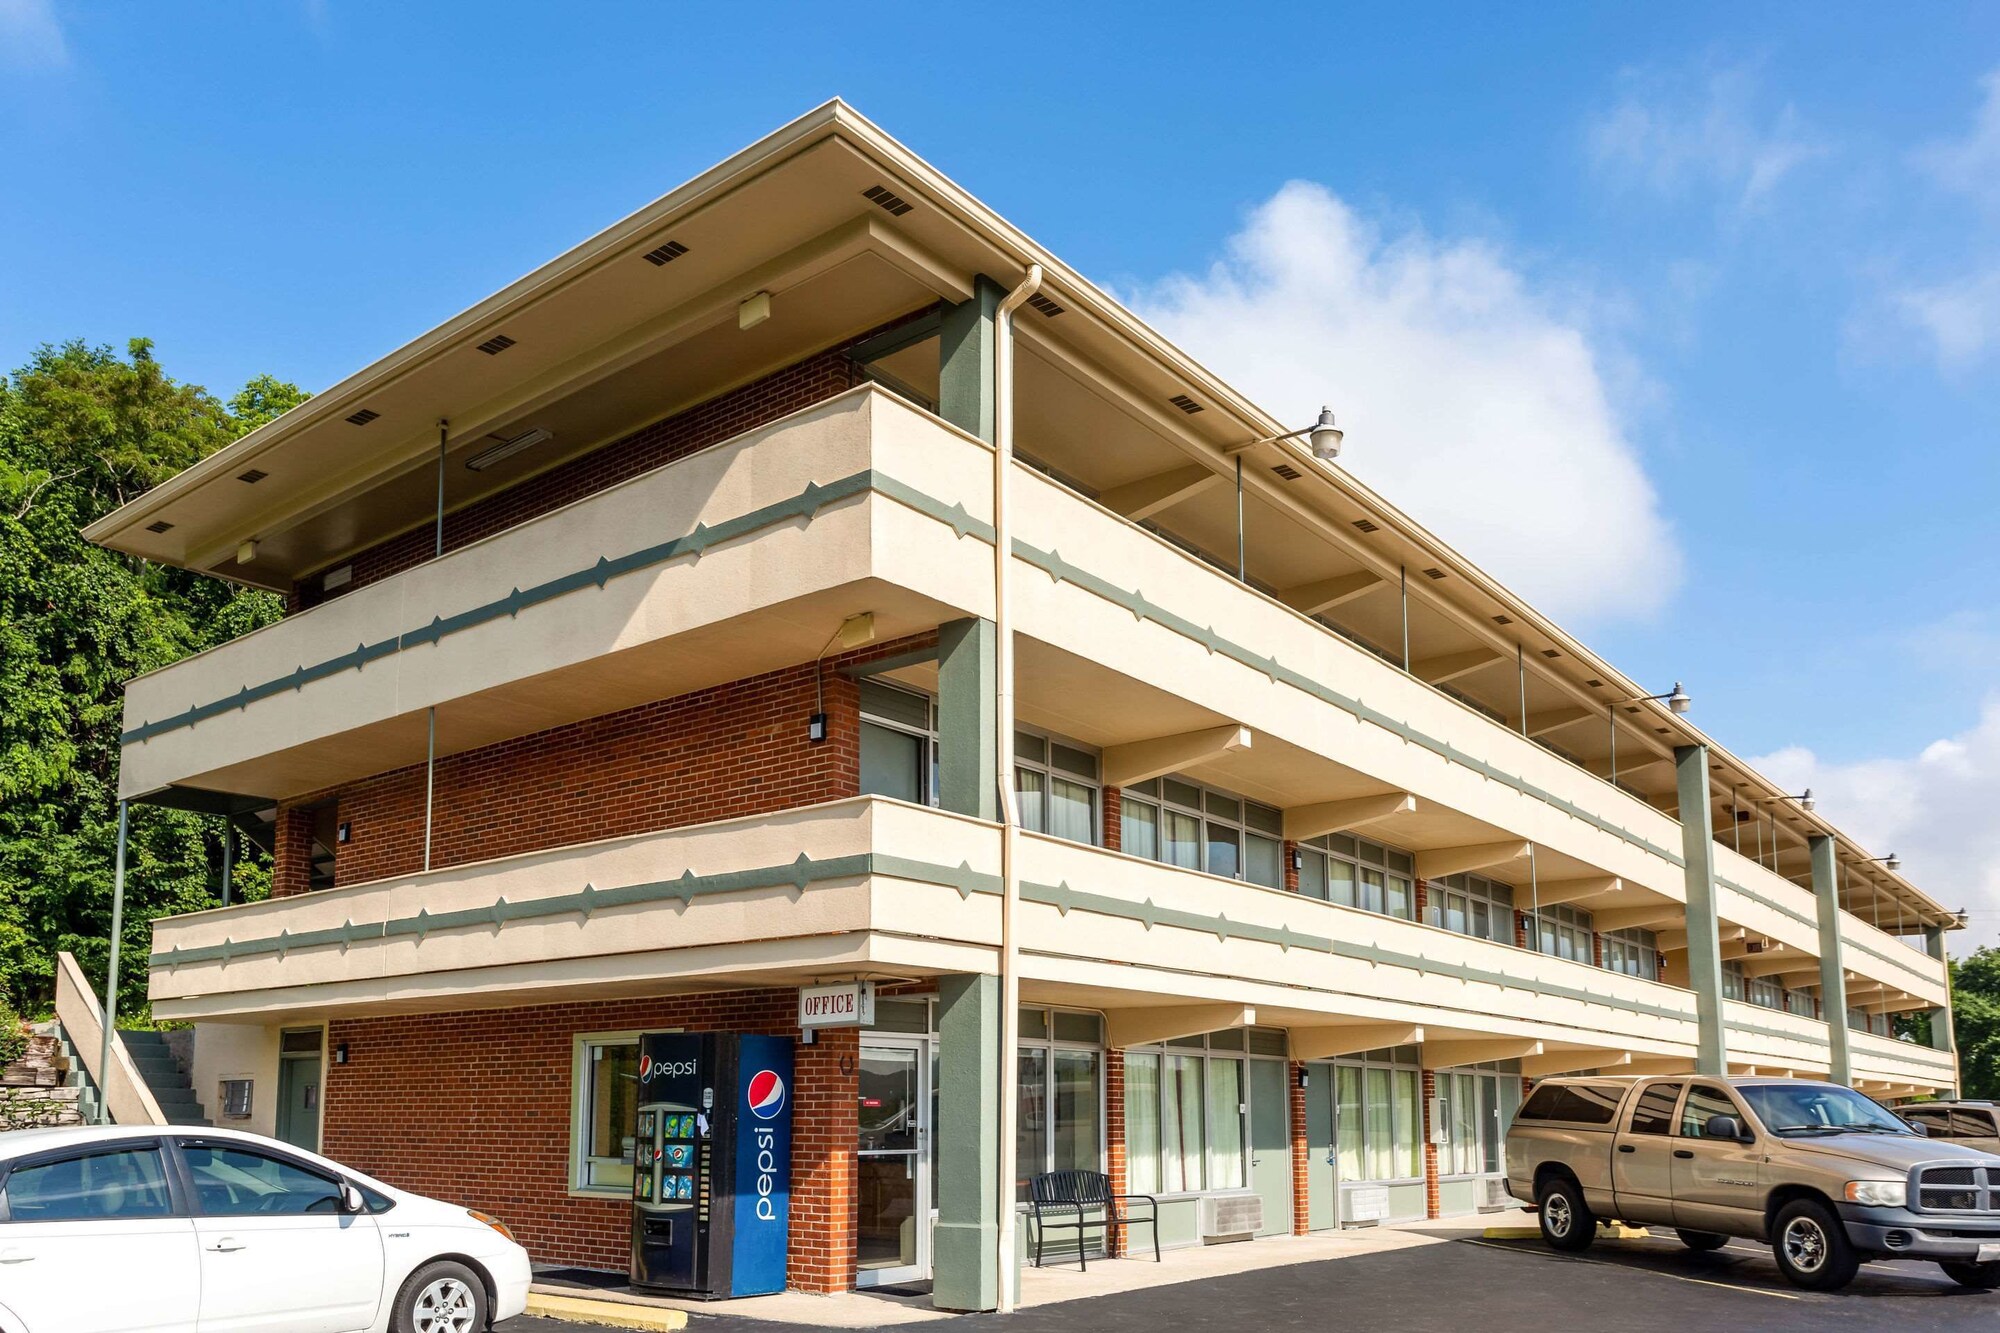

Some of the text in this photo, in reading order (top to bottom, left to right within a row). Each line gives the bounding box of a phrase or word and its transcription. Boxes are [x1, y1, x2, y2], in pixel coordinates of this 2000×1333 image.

[805, 993, 854, 1016] OFFICE
[653, 1058, 697, 1079] pepsi
[754, 1127, 778, 1220] pepsi
